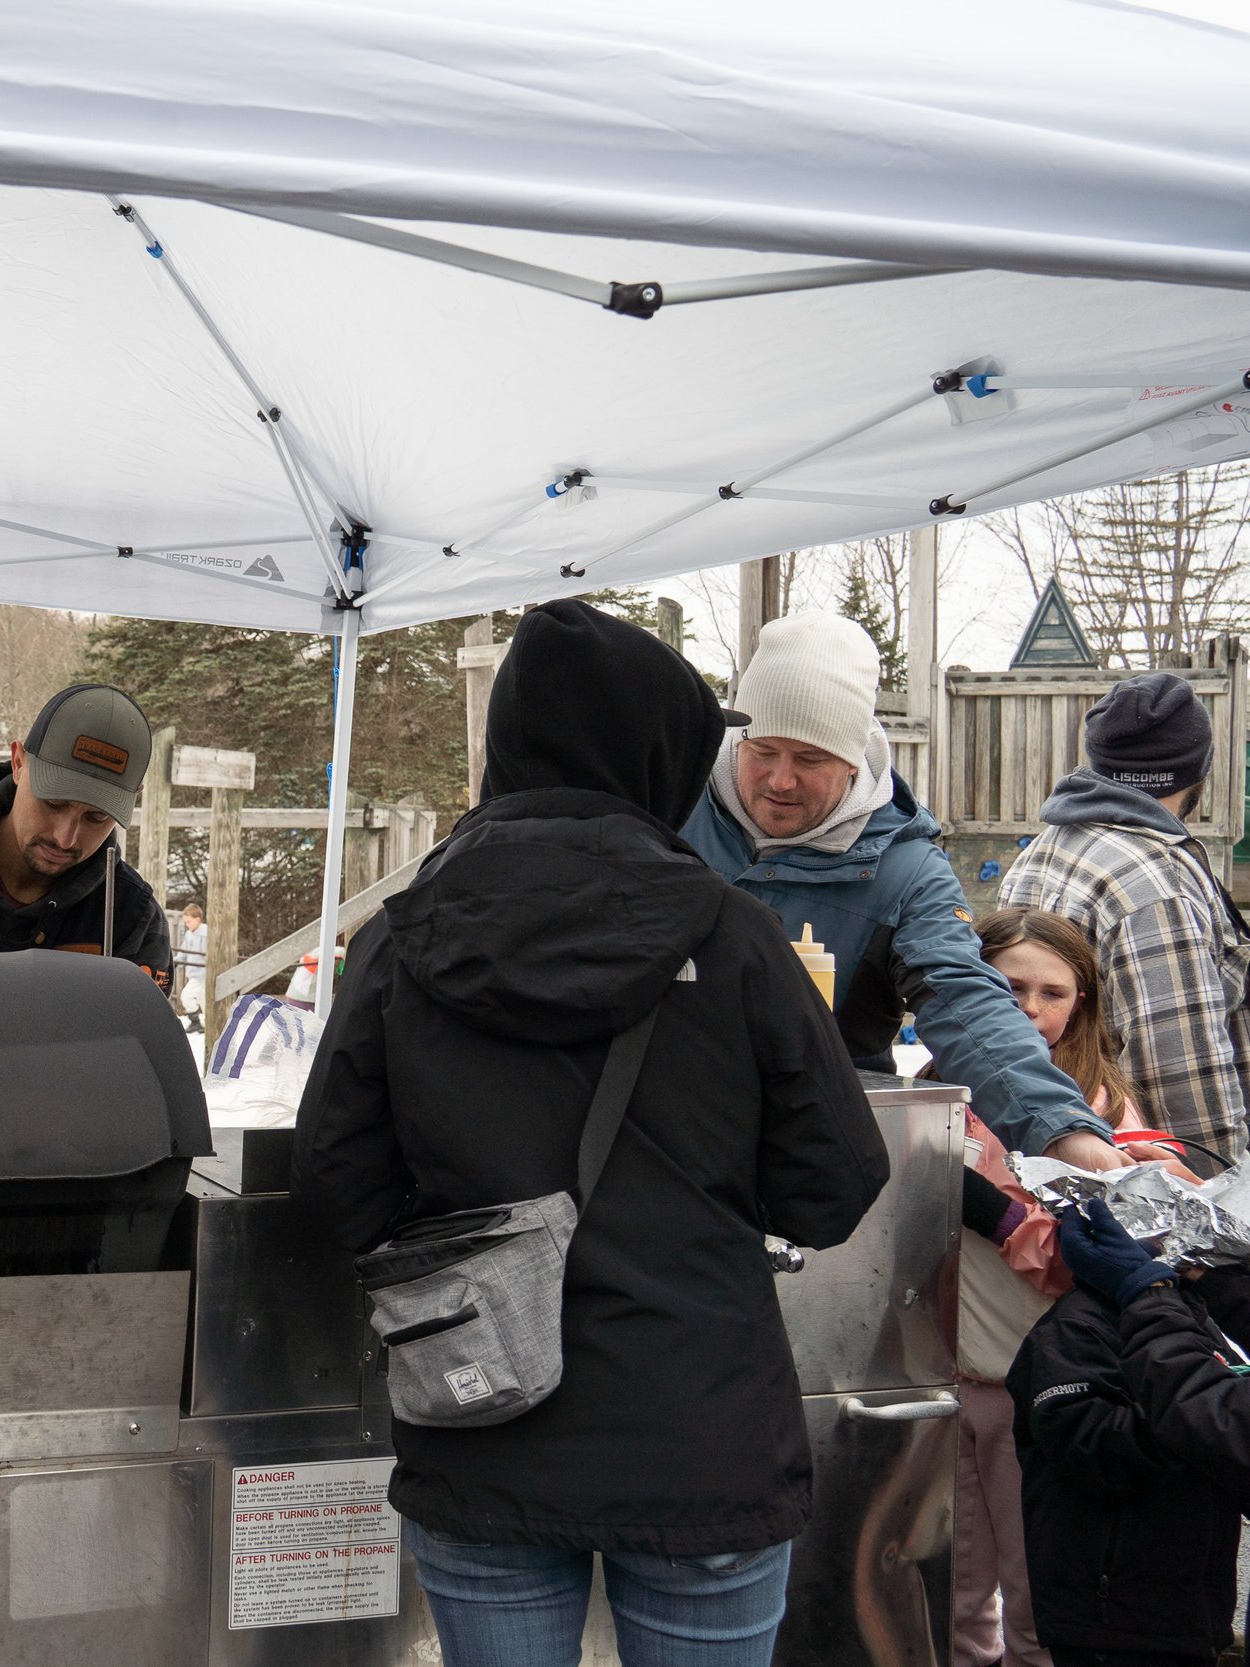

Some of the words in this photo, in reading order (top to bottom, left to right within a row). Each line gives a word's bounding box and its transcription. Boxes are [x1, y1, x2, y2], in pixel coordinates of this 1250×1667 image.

[1113, 772, 1174, 782] LISCOMBE
[250, 1471, 295, 1483] DANGER
[236, 1512, 274, 1522] BEFORE
[278, 1509, 319, 1519] TURNING
[323, 1508, 336, 1516] ON
[341, 1504, 382, 1515] PROPANE
[235, 1555, 266, 1565] AFTER
[270, 1552, 311, 1562] TURNING
[315, 1550, 328, 1559] ON
[333, 1548, 350, 1557] THE
[354, 1545, 396, 1556] PROPANE
